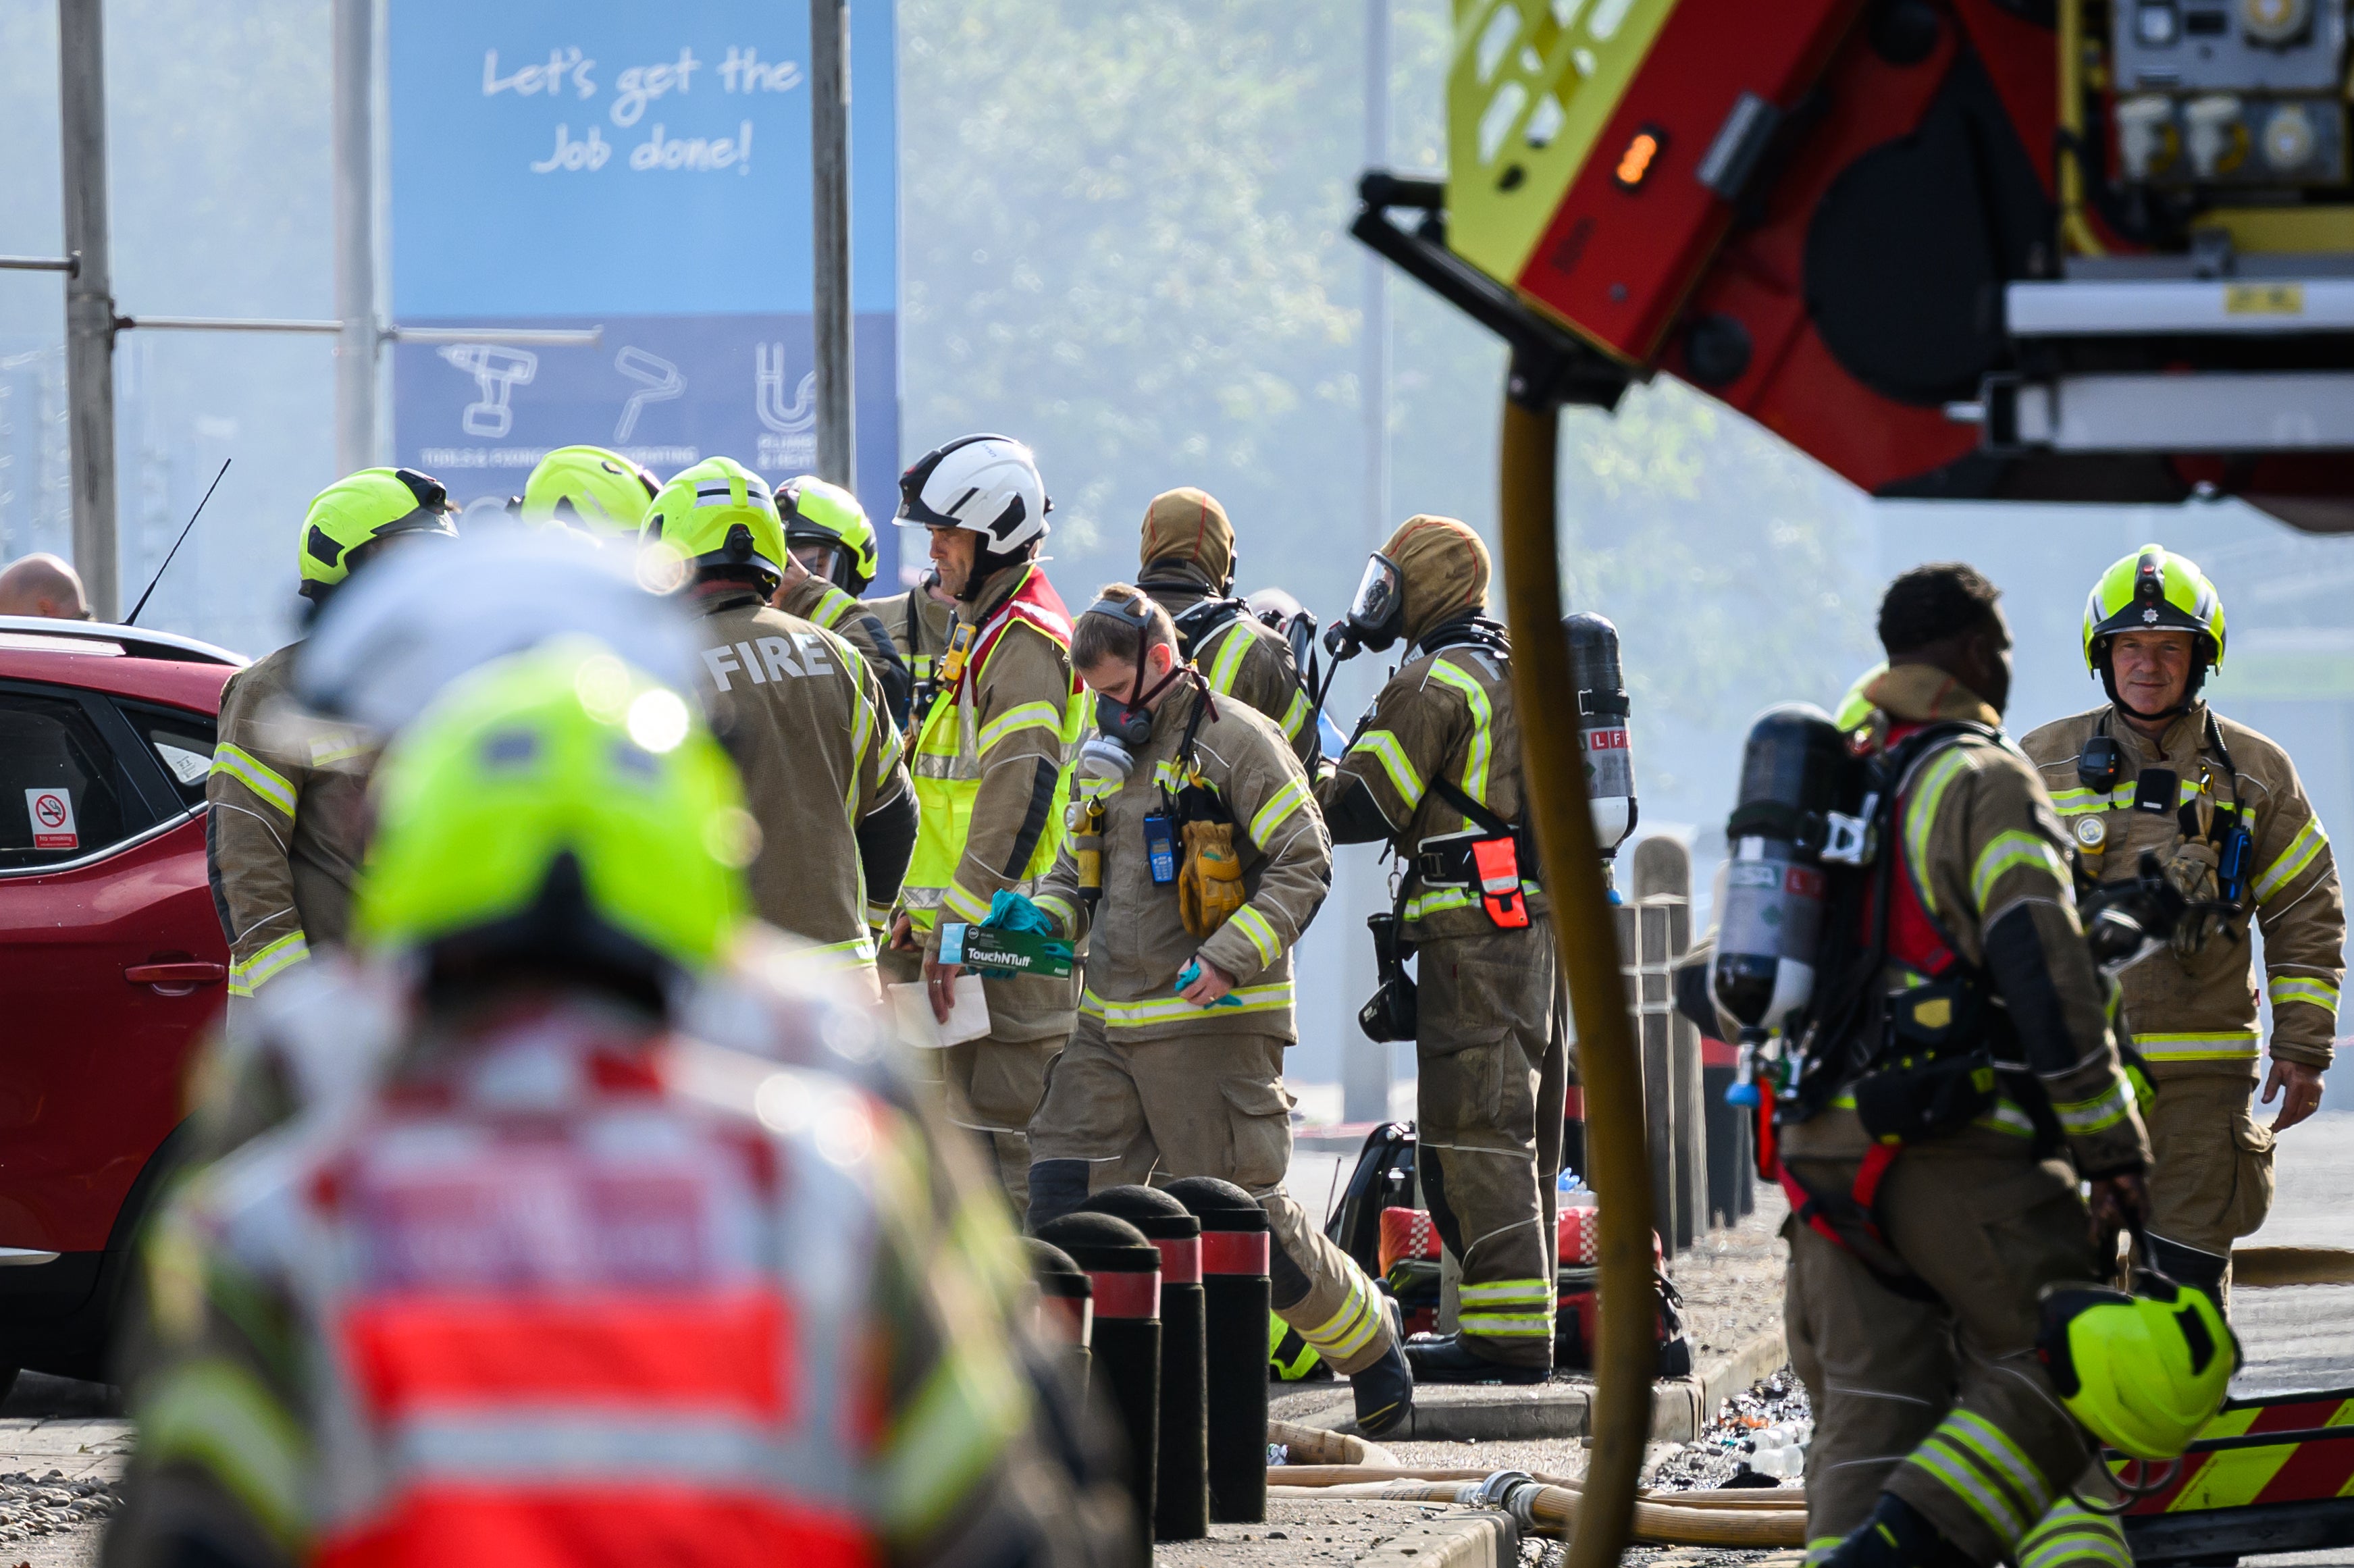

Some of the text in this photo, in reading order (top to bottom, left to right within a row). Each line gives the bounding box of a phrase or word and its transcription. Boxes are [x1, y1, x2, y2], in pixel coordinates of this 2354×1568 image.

[483, 47, 802, 126] Let's get the
[531, 120, 753, 176] Job done!
[701, 633, 834, 691] FIRE
[967, 947, 1031, 967] TouchNTuff
